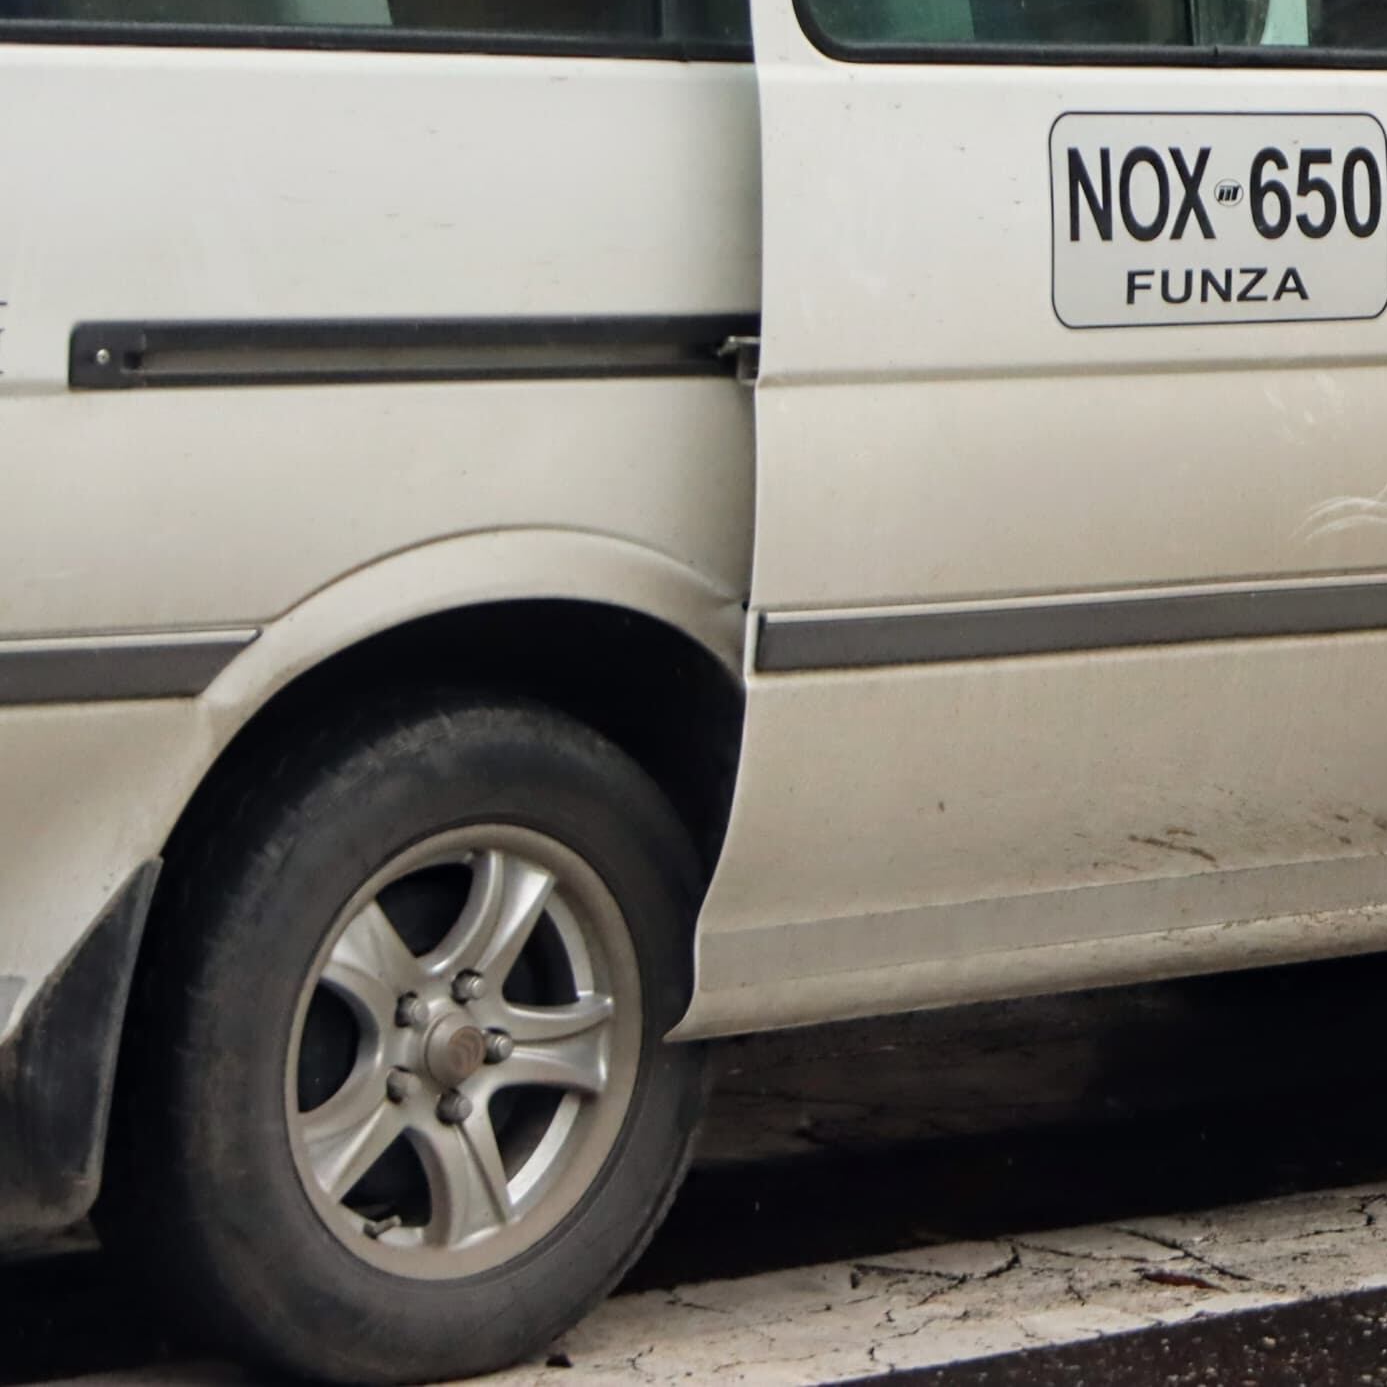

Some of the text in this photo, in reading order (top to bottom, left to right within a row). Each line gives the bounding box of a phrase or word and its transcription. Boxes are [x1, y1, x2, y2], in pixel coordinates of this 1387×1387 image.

[1067, 146, 1382, 242] NOX 650
[1126, 267, 1310, 305] FUNZA
